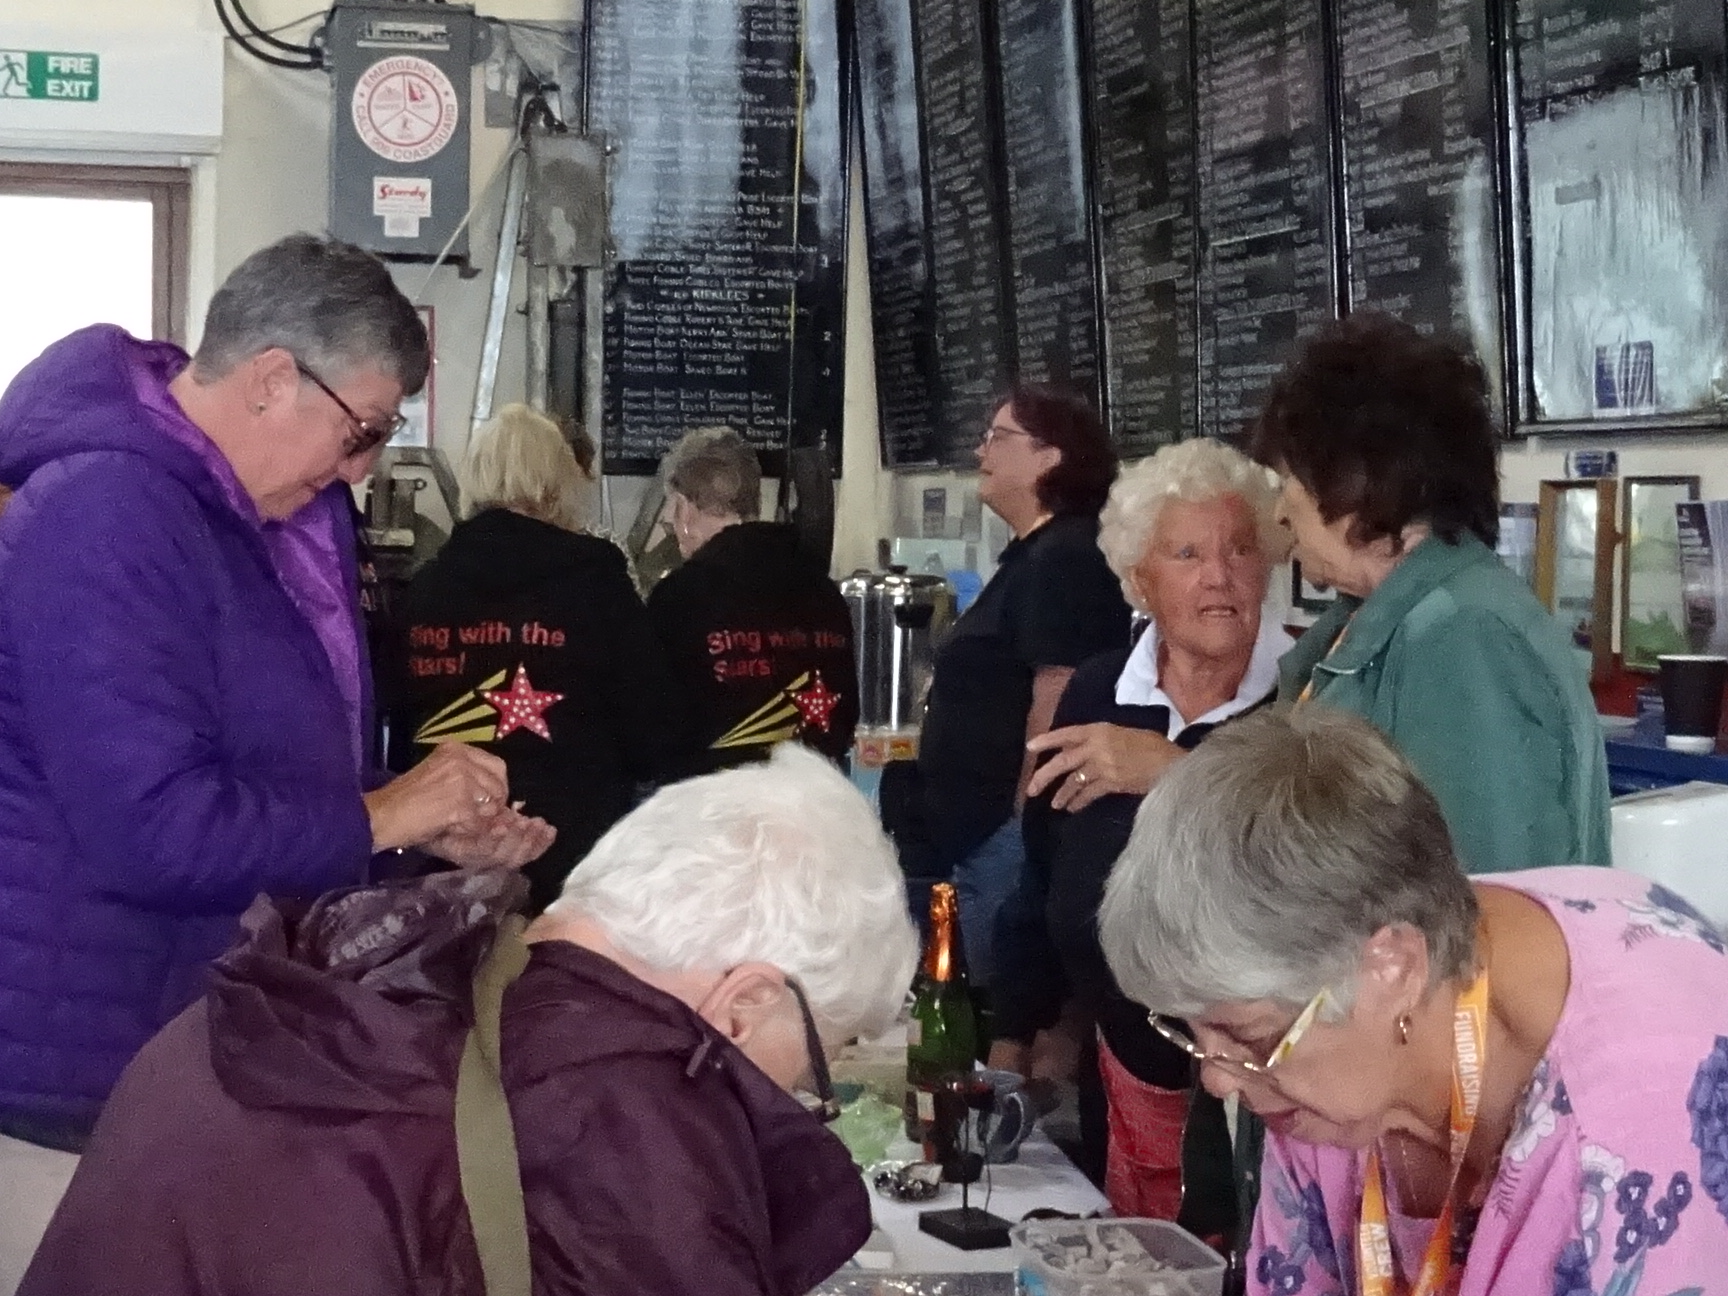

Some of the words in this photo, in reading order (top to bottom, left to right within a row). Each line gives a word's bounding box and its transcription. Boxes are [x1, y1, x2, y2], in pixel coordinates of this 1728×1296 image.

[47, 56, 93, 75] FIRE
[46, 78, 93, 99] EXIT
[458, 620, 512, 646] with
[520, 621, 566, 648] the
[706, 628, 762, 655] Sing
